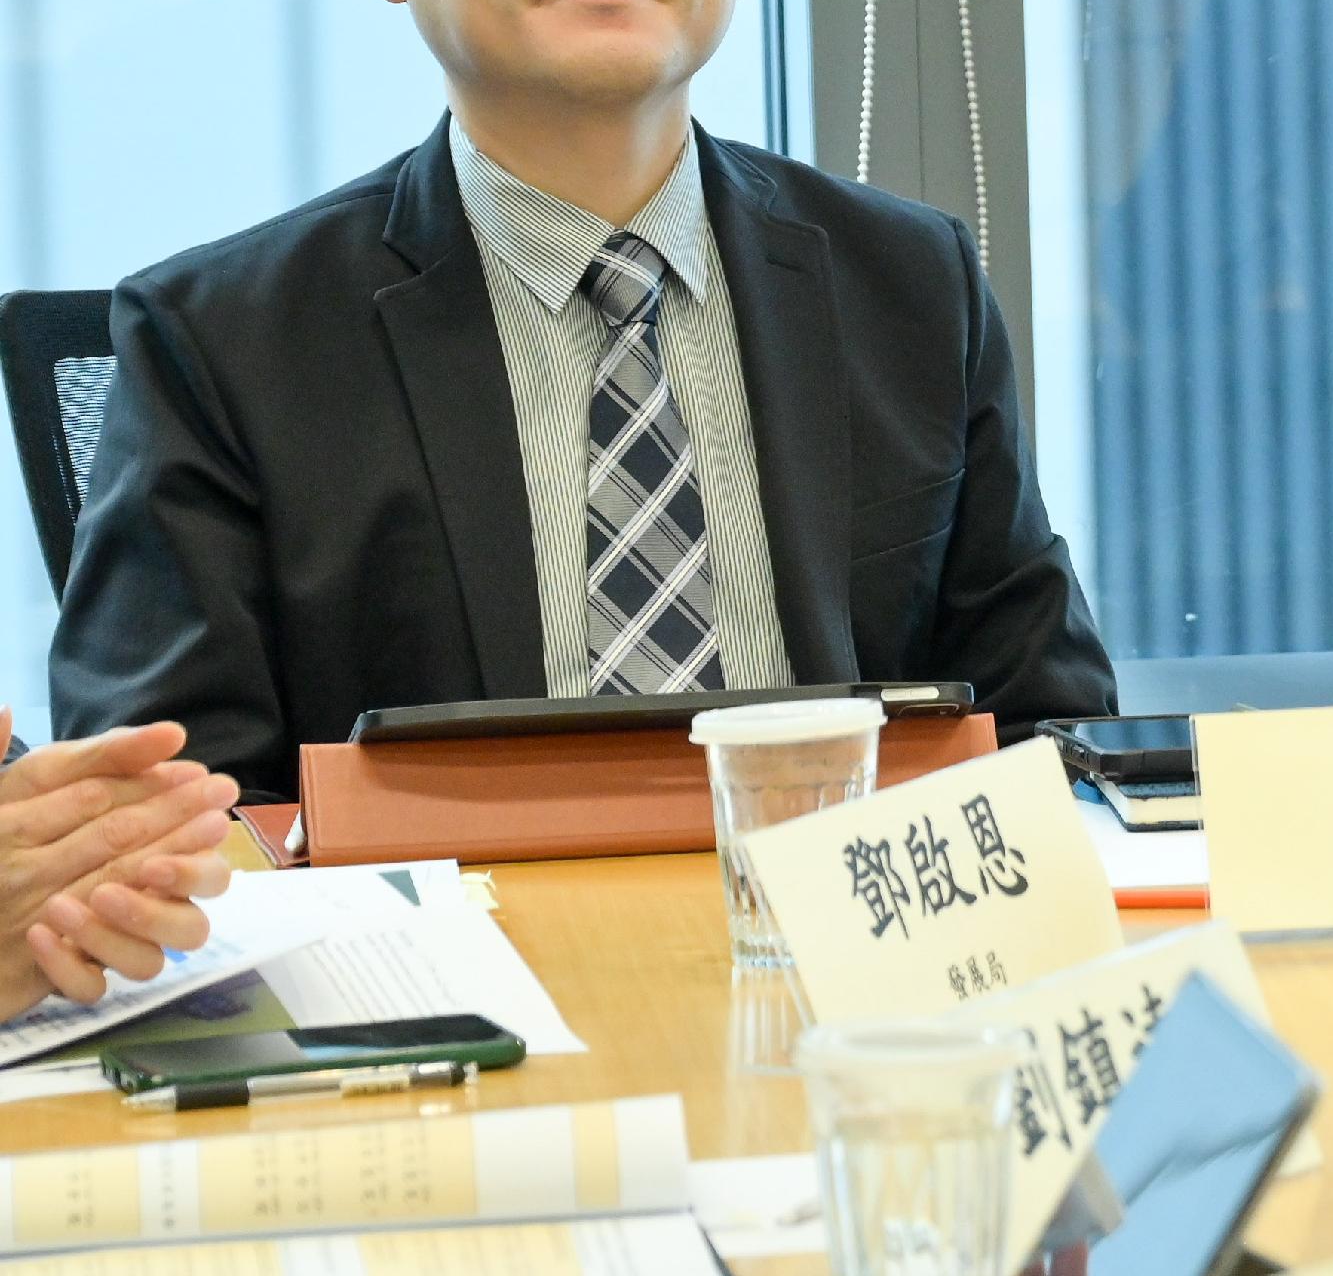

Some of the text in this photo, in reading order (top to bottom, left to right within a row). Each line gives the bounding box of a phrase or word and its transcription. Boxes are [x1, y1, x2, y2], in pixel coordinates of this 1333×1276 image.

[843, 793, 1029, 940] 鄧啟恩
[948, 950, 1007, 1001] 發展局
